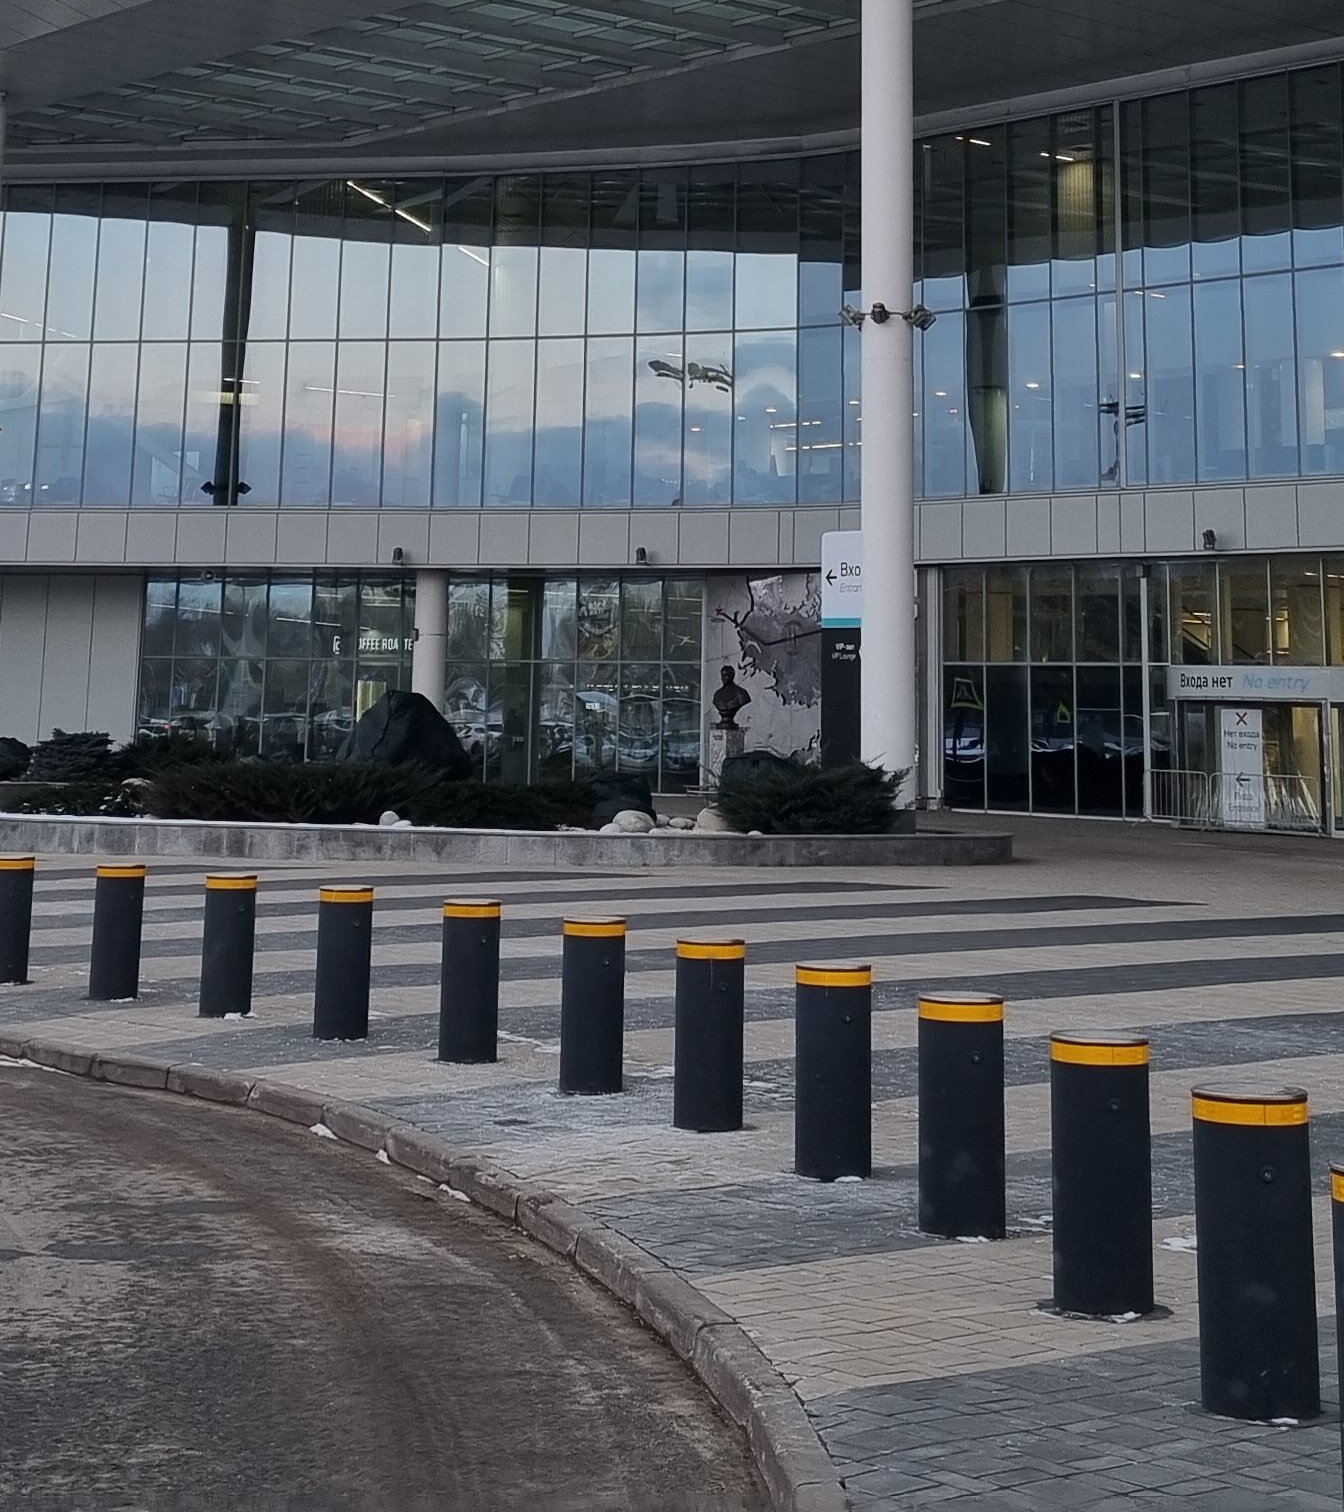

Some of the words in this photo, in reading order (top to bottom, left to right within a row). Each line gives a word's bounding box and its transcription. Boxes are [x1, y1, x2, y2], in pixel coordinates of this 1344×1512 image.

[840, 562, 861, 577] Вхо
[1180, 673, 1208, 689] Входа
[1212, 675, 1233, 688] нет
[1242, 674, 1262, 689] No
[1268, 676, 1312, 693] entry
